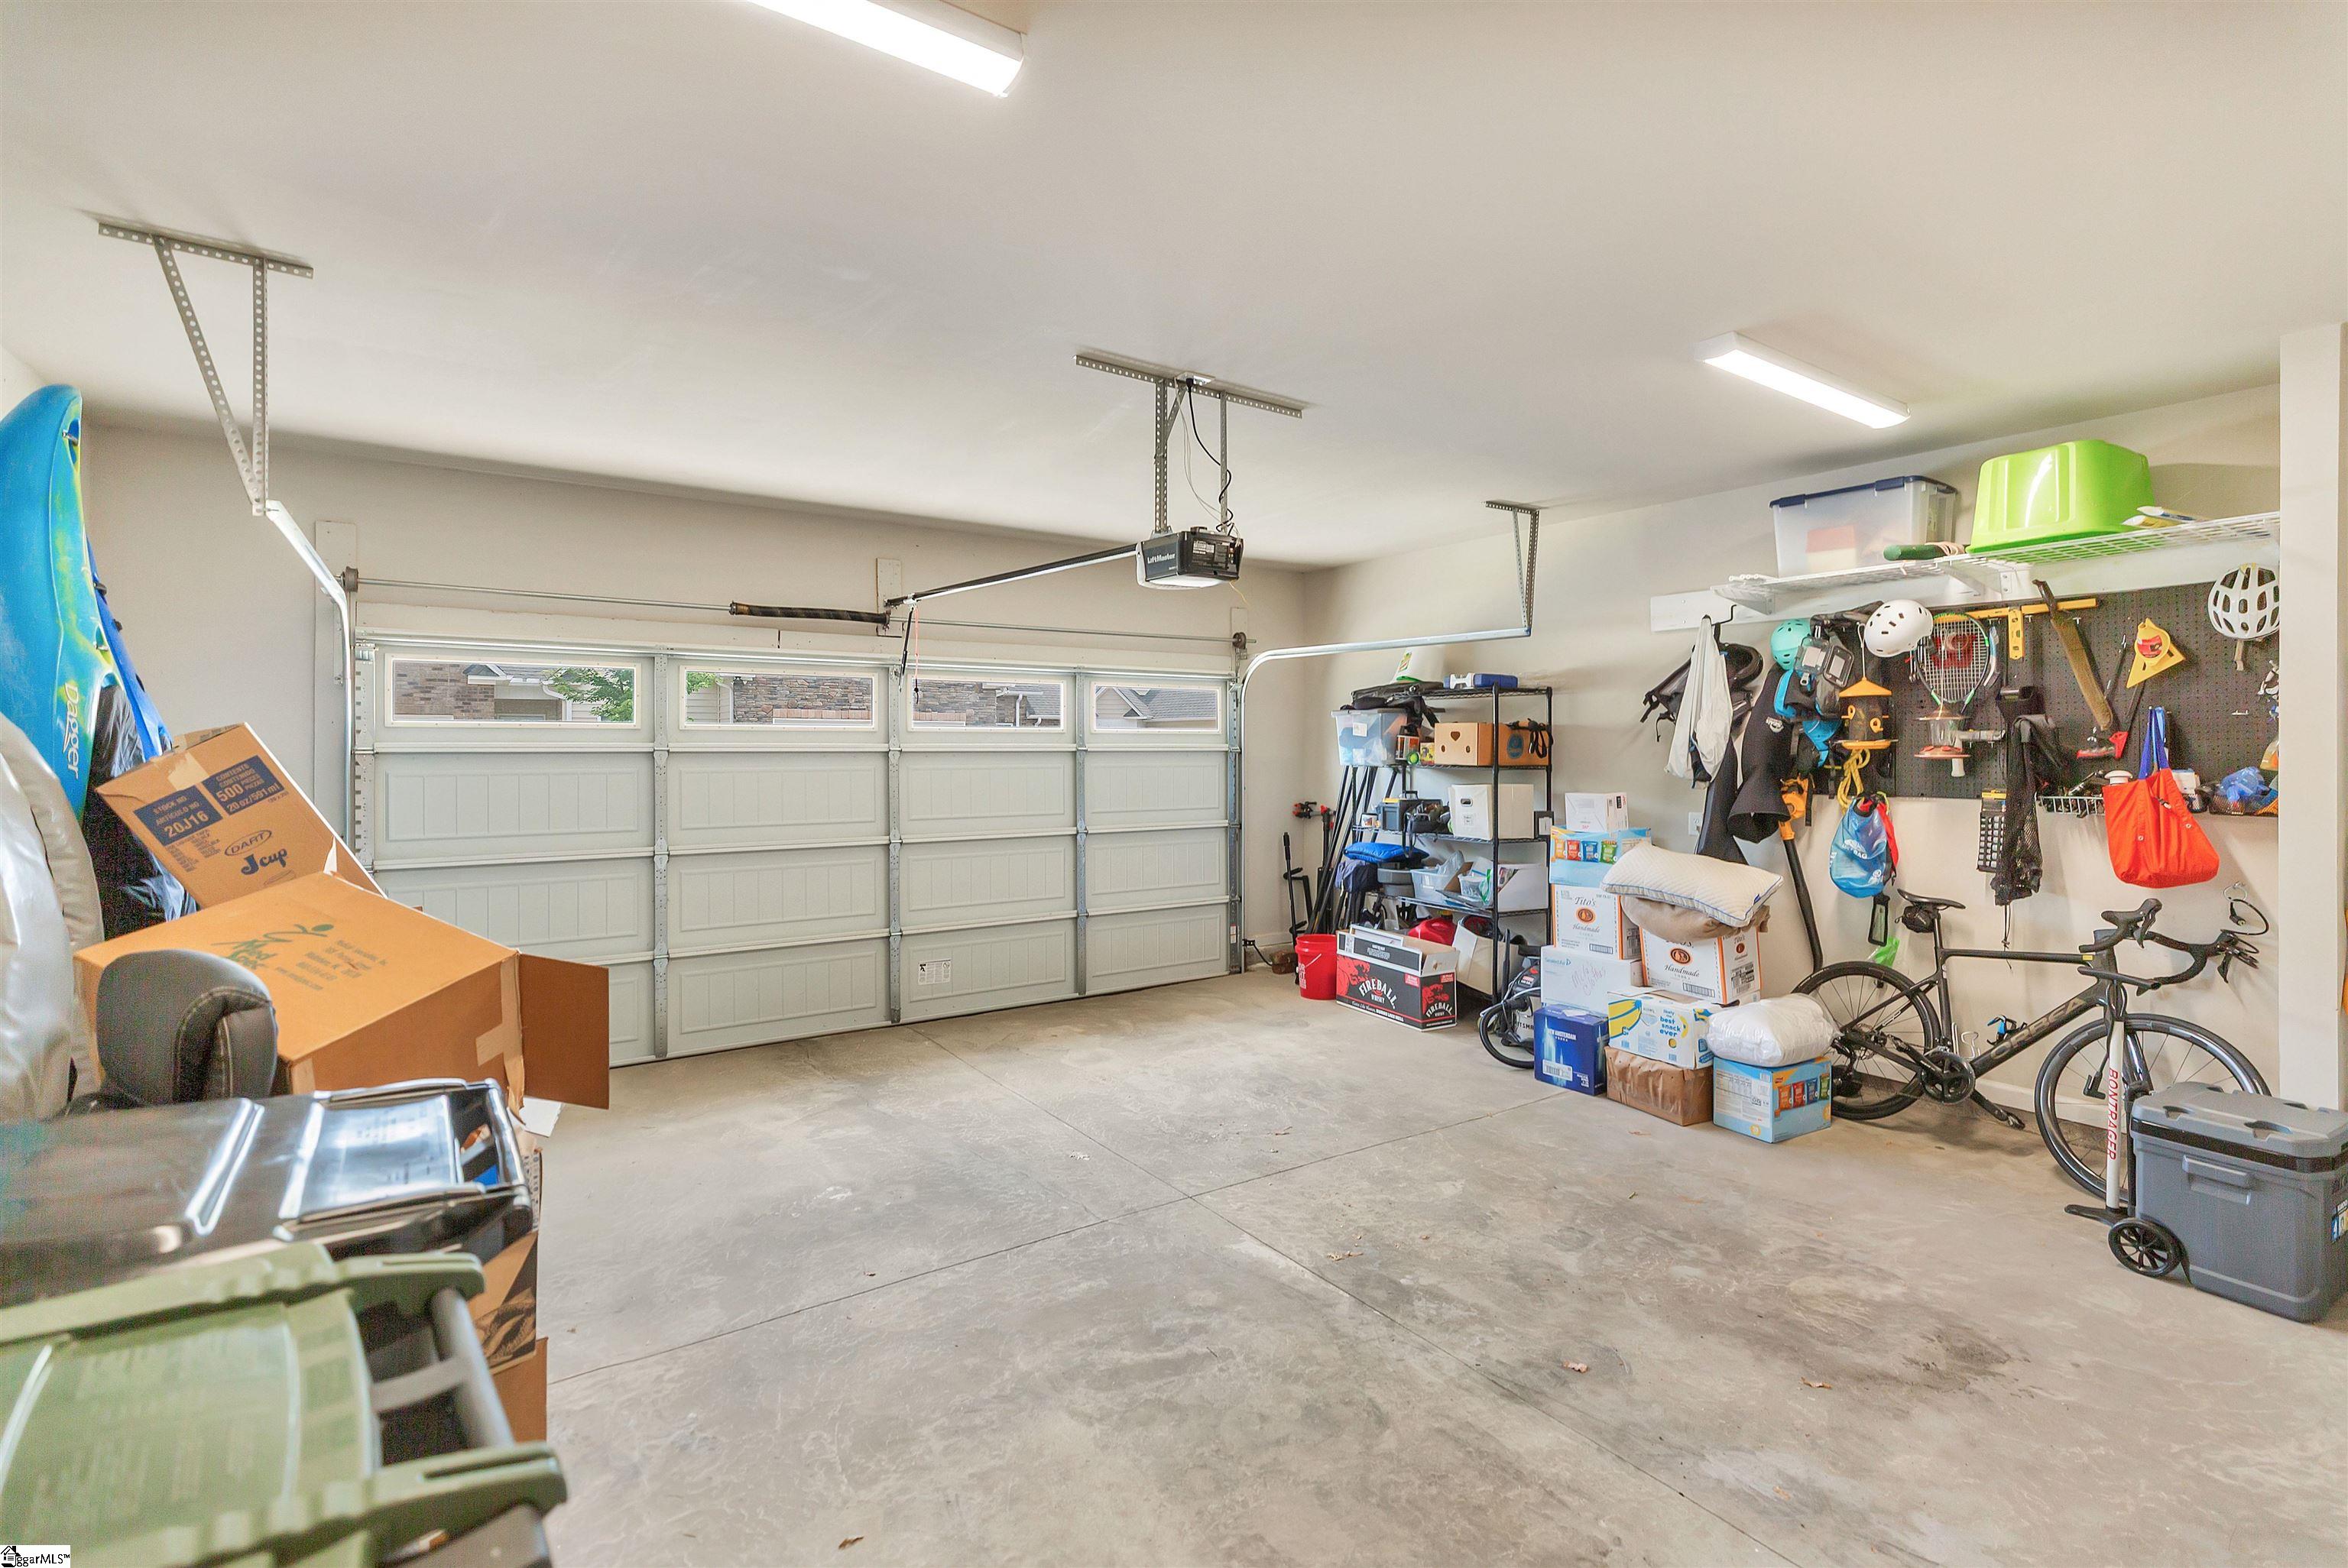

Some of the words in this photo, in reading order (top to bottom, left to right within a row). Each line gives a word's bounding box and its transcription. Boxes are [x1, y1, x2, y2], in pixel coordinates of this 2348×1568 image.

[1147, 552, 1176, 564] LiftMaster
[63, 682, 79, 779] Dagger
[216, 783, 244, 802] 500
[164, 811, 209, 837] 20J16
[231, 832, 265, 854] DART
[1575, 896, 1596, 906] Tito's
[1572, 923, 1600, 933] Handmade
[1664, 964, 1700, 977] Handmade
[1358, 978, 1397, 1007] FIREBALL
[1425, 1002, 1452, 1018] FIREBALL
[1659, 1016, 1675, 1025] best
[1661, 1023, 1681, 1032] snack
[1659, 1029, 1678, 1037] ever
[2106, 1067, 2119, 1160] BONTRAGER
